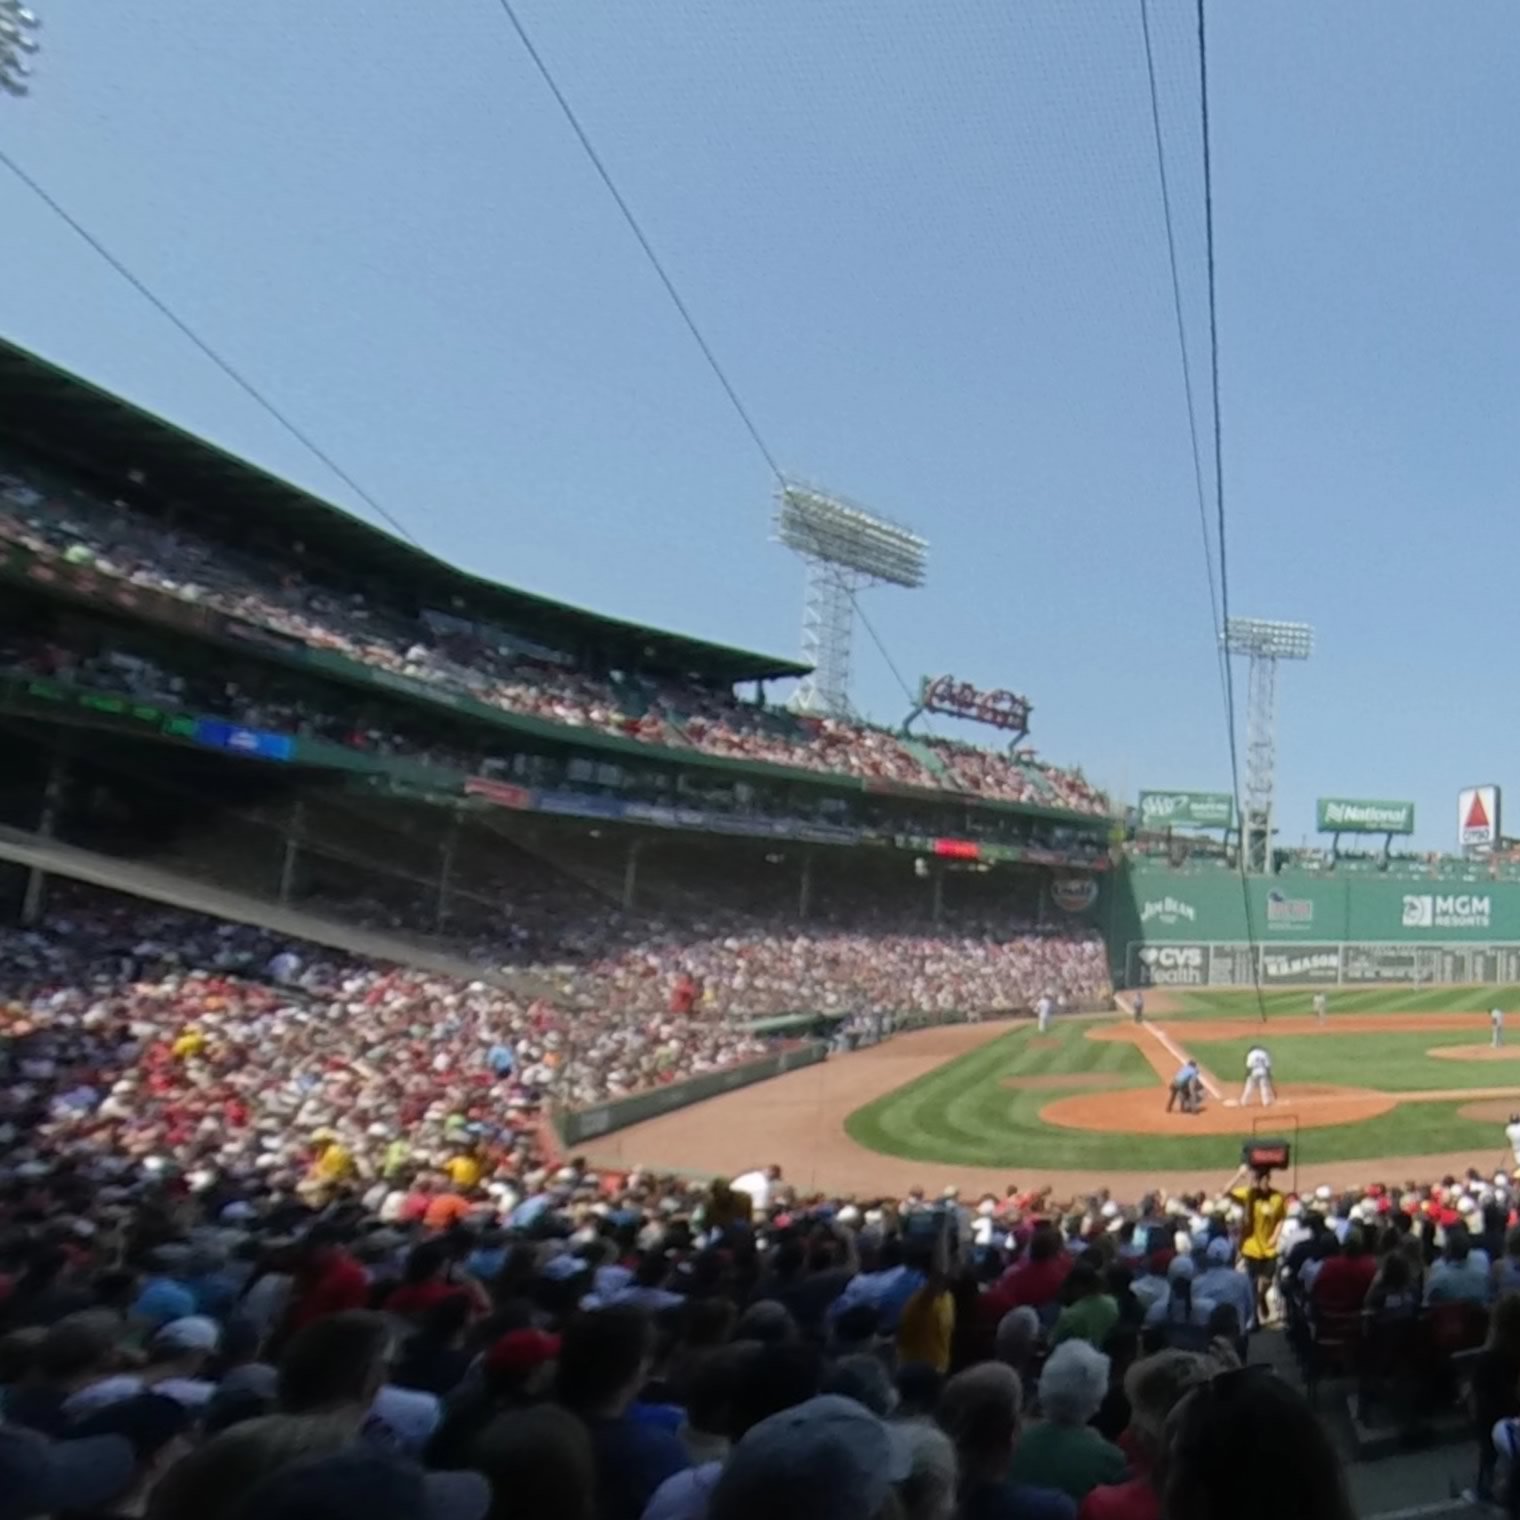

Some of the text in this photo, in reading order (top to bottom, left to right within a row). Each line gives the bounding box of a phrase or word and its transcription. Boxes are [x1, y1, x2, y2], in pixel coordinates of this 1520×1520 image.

[1344, 805, 1406, 823] National
[1435, 895, 1490, 915] MGM
[1435, 915, 1490, 927] RESORTS
[1159, 948, 1202, 966] CVS
[1141, 965, 1200, 983] Health
